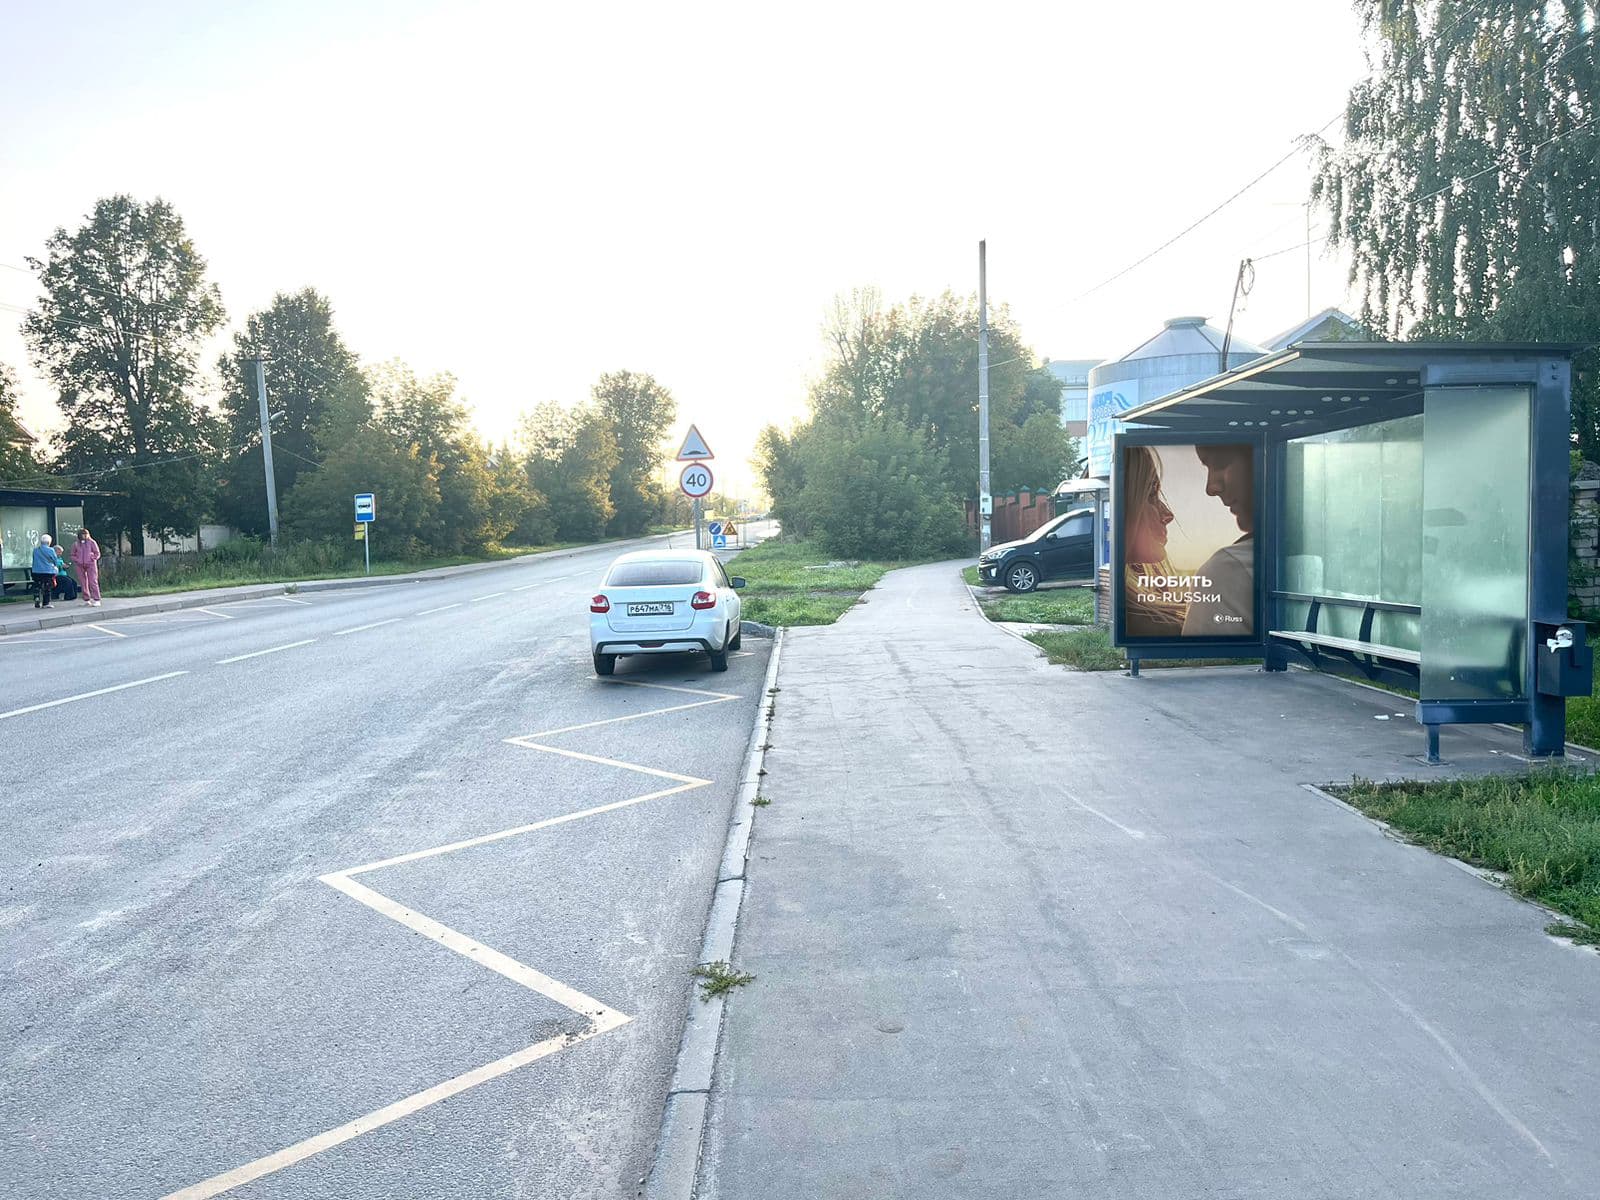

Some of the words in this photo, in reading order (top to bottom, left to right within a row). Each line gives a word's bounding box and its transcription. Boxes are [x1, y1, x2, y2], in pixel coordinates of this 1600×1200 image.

[686, 473, 707, 487] 40
[1137, 576, 1213, 588] ЛЮБИТЬ
[1137, 591, 1221, 603] по-RUSSки
[1224, 615, 1243, 623] Russ
